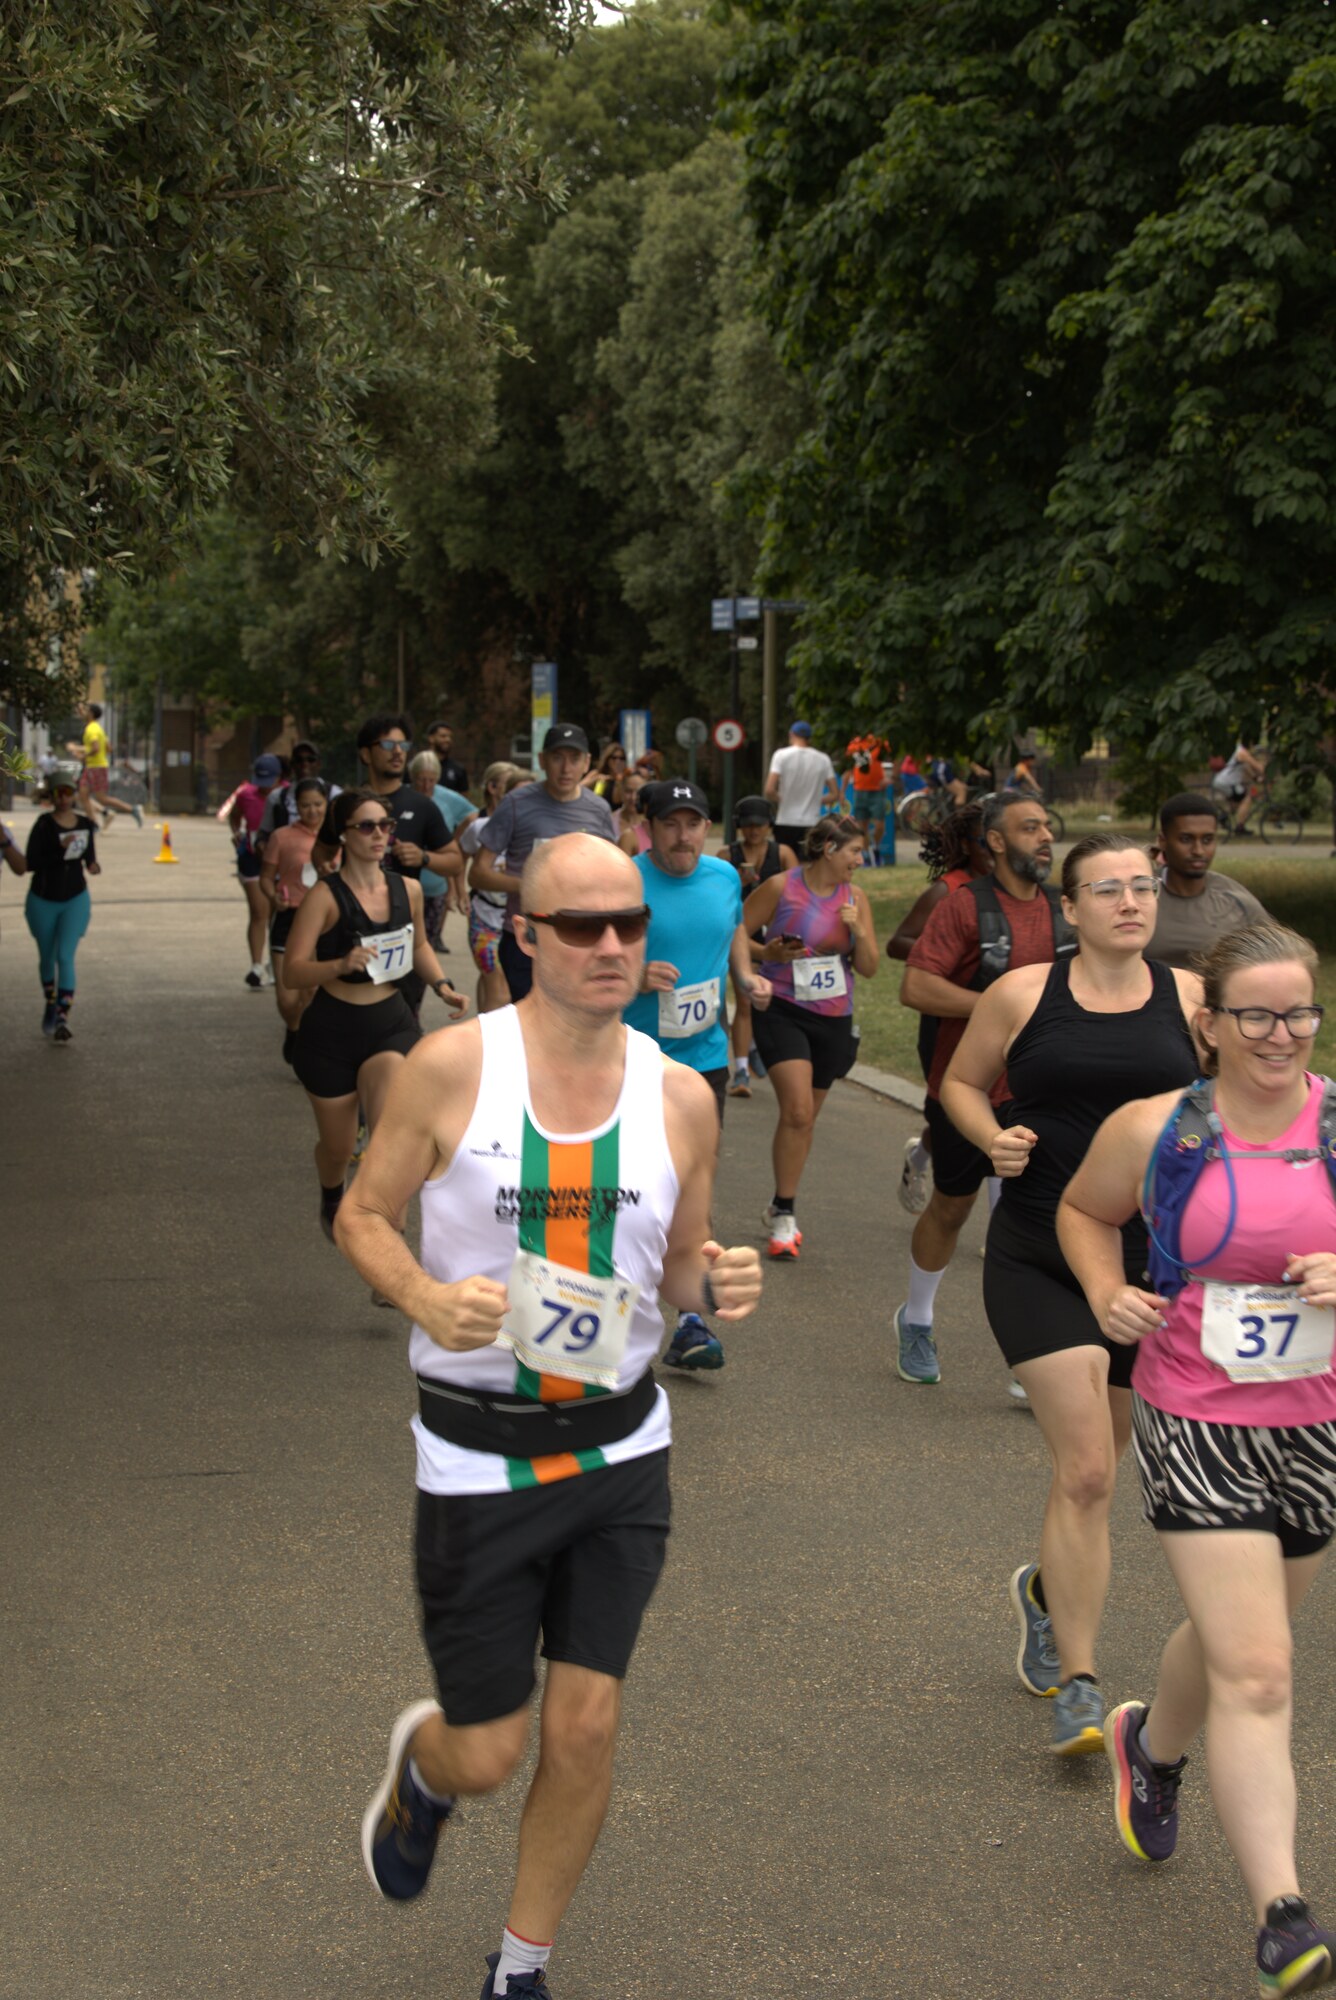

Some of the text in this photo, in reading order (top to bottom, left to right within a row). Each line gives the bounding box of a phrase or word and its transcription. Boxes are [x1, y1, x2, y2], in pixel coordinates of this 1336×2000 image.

[724, 729, 733, 742] 5
[380, 945, 405, 970] 77
[810, 970, 835, 989] 45
[678, 1000, 706, 1025] 70
[496, 1184, 641, 1206] MORNINGTON
[533, 1297, 601, 1353] 79
[1235, 1313, 1300, 1358] 37
